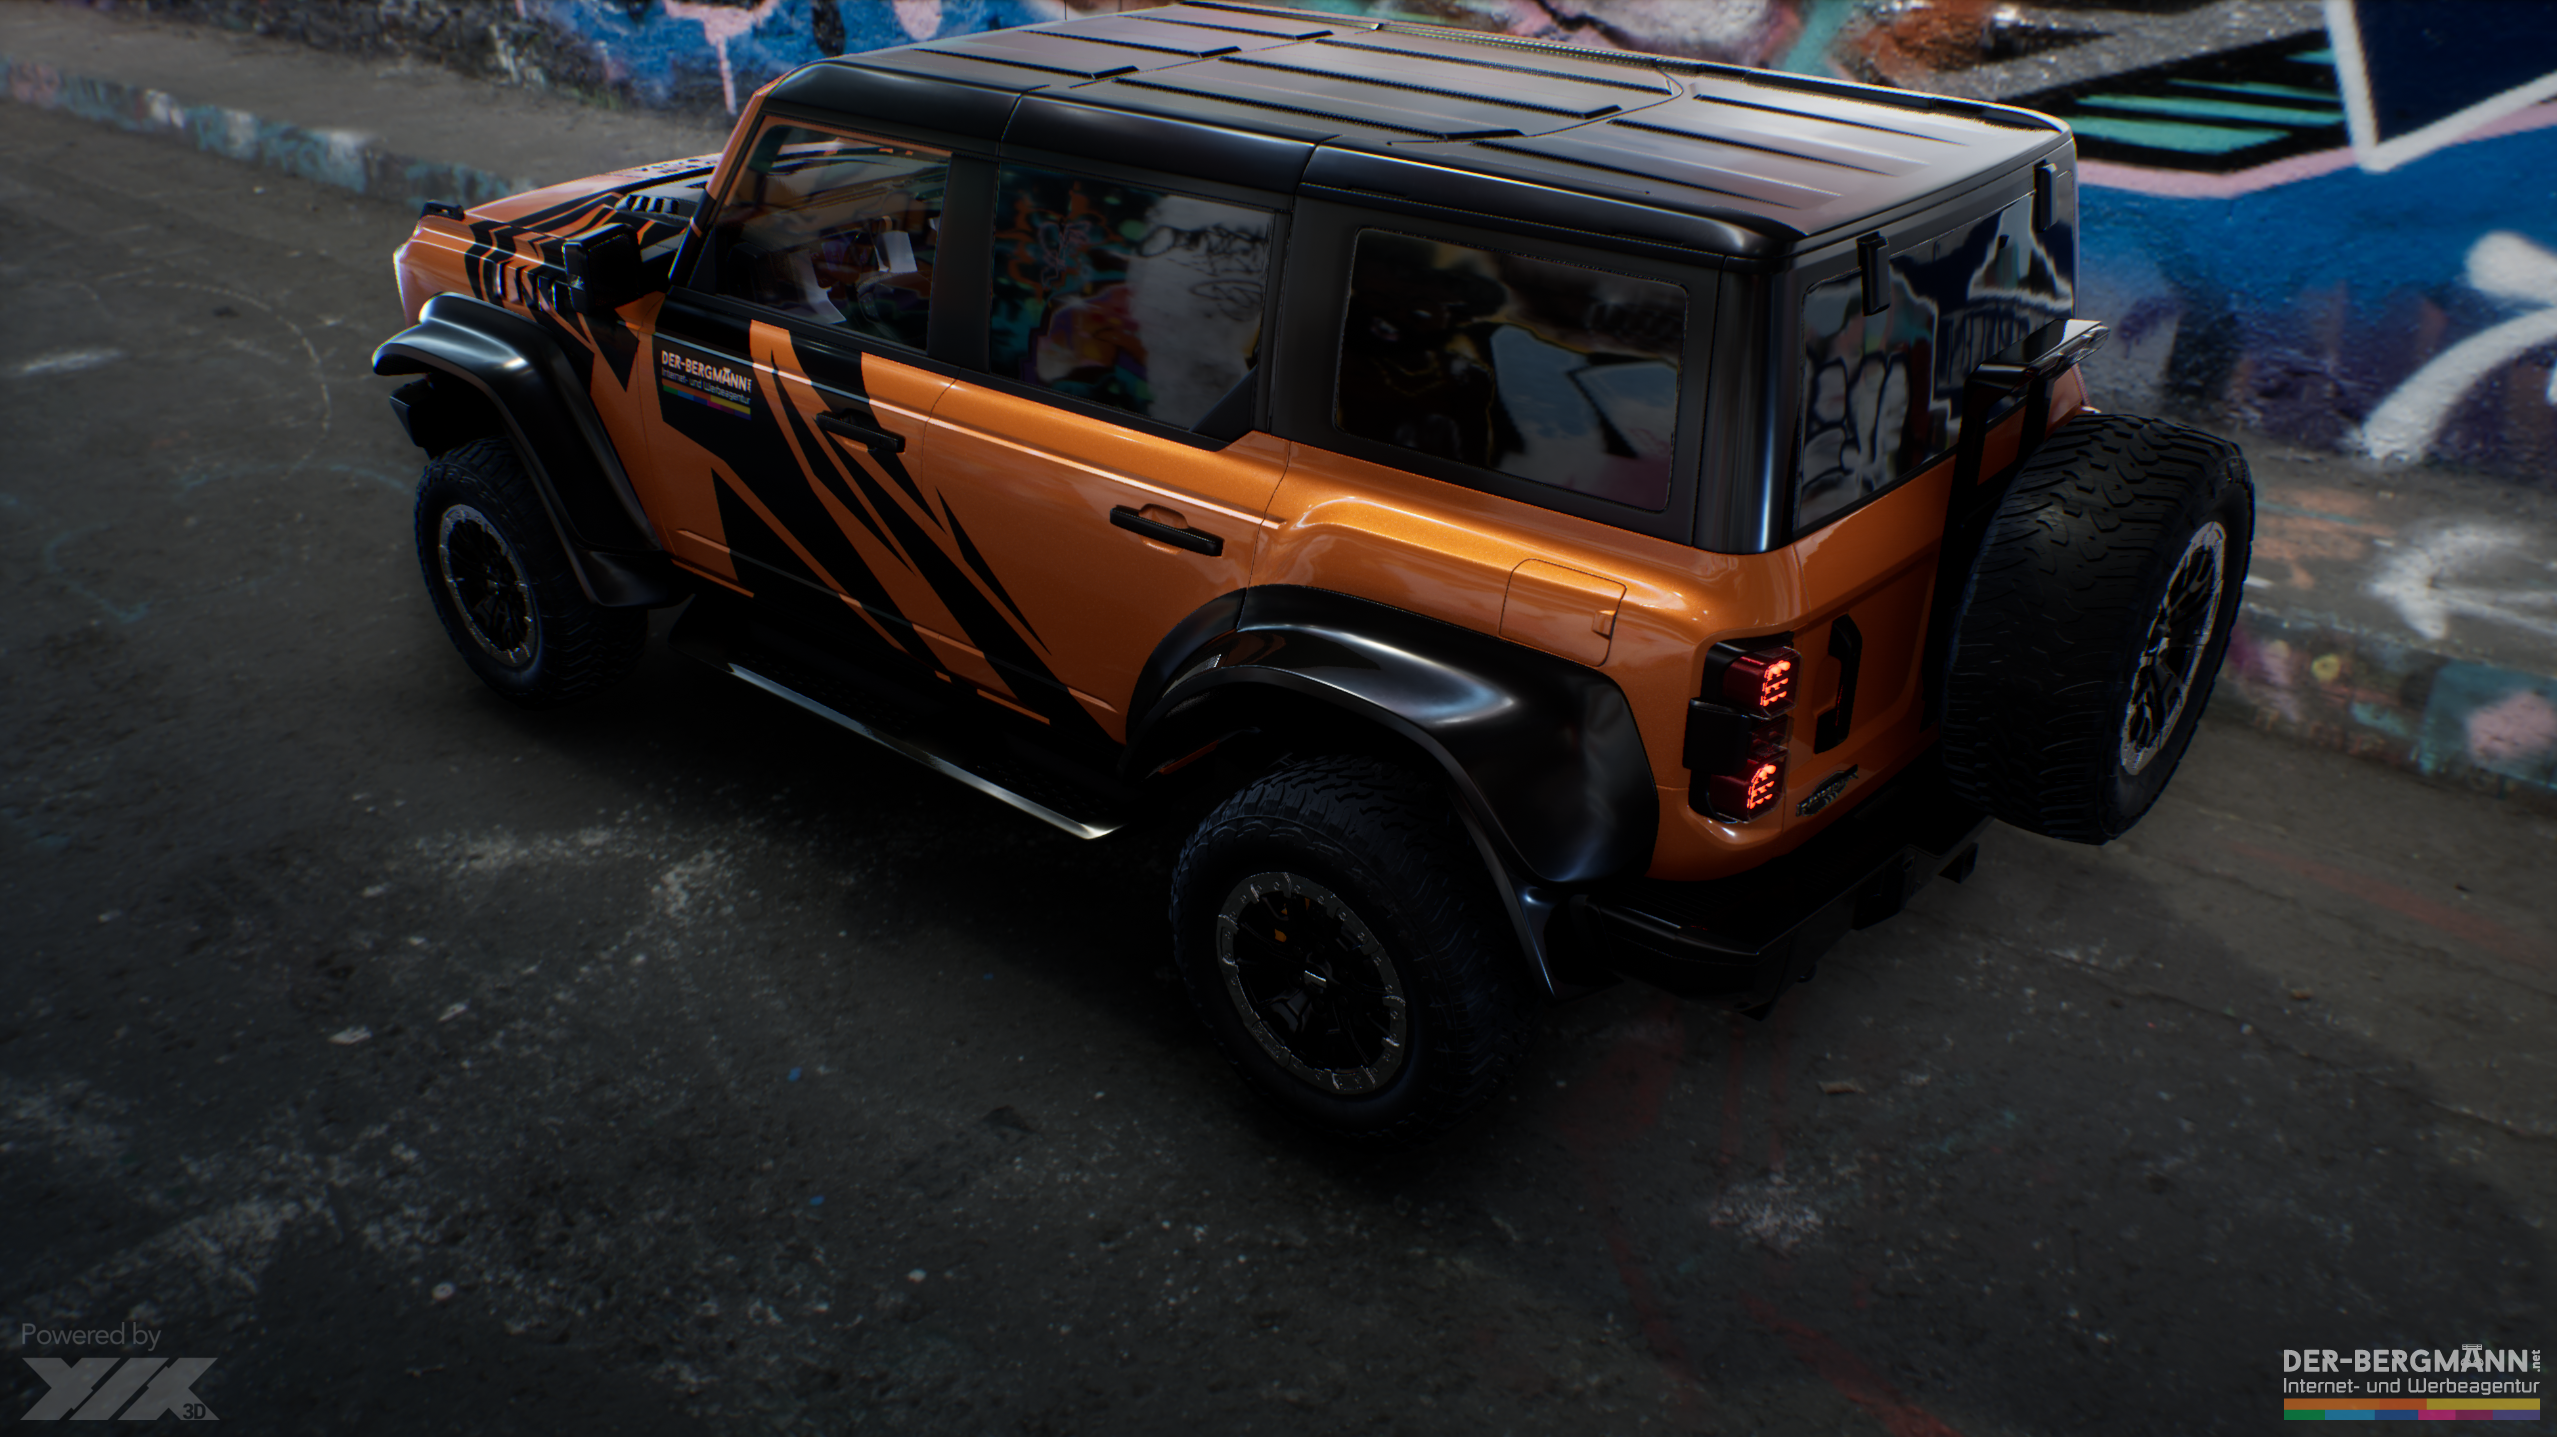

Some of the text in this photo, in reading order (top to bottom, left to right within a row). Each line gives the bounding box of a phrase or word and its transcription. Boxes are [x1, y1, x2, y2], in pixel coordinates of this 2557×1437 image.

[661, 366, 688, 384] Internet-
[689, 379, 702, 389] und
[703, 382, 751, 404] Werbeagentur
